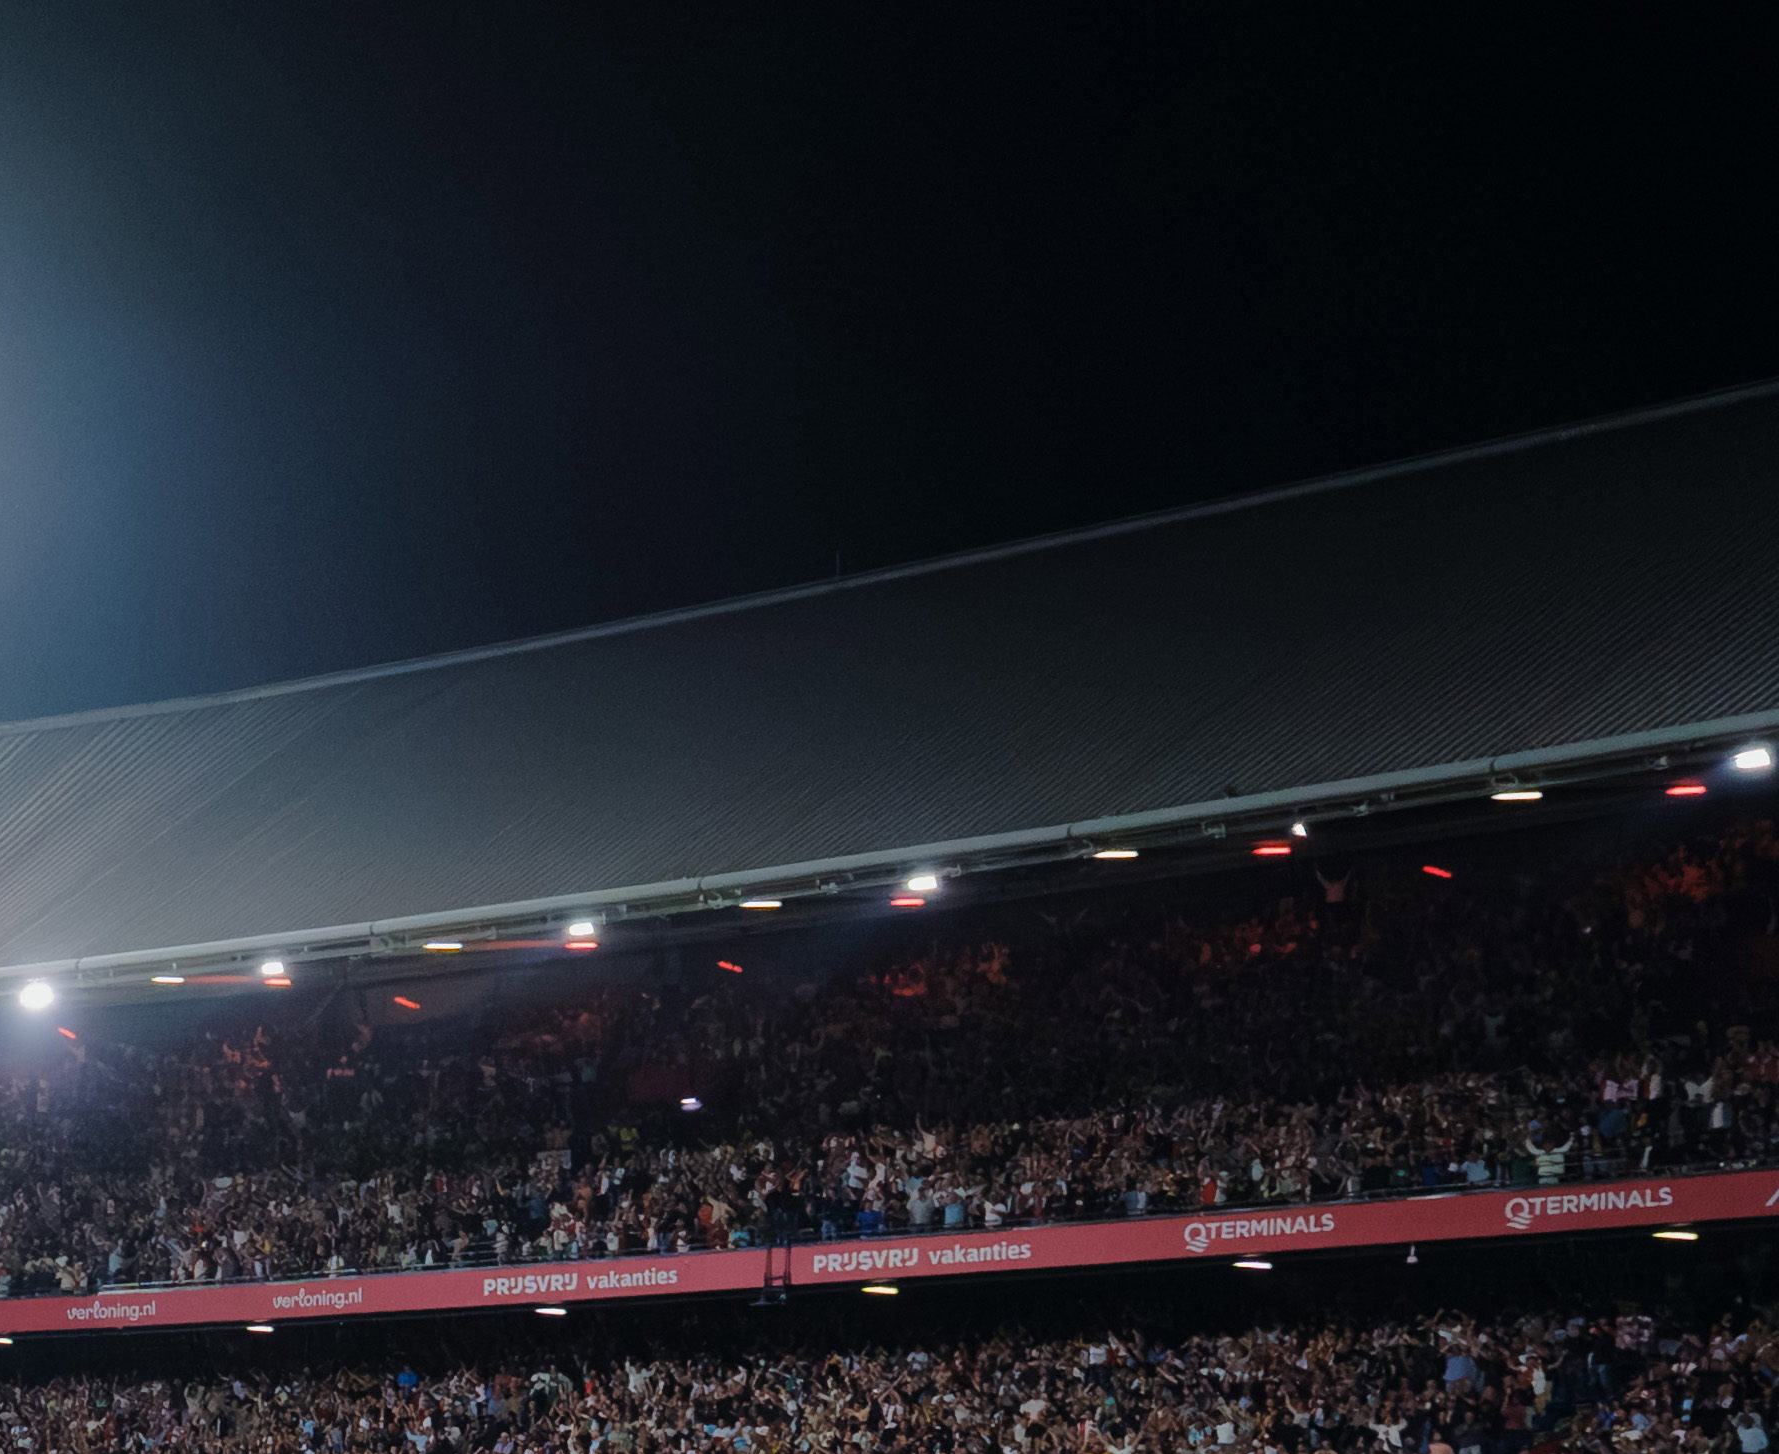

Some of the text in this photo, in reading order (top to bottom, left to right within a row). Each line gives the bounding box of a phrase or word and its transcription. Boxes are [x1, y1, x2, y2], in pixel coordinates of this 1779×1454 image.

[1505, 1187, 1673, 1229] QTERMINALS
[1184, 1213, 1335, 1252] QTERMINALS
[928, 1241, 1032, 1265] vakanties
[586, 1269, 678, 1289] vakanties
[273, 1287, 362, 1309] verloning.nl
[67, 1300, 156, 1321] verloning.nl
